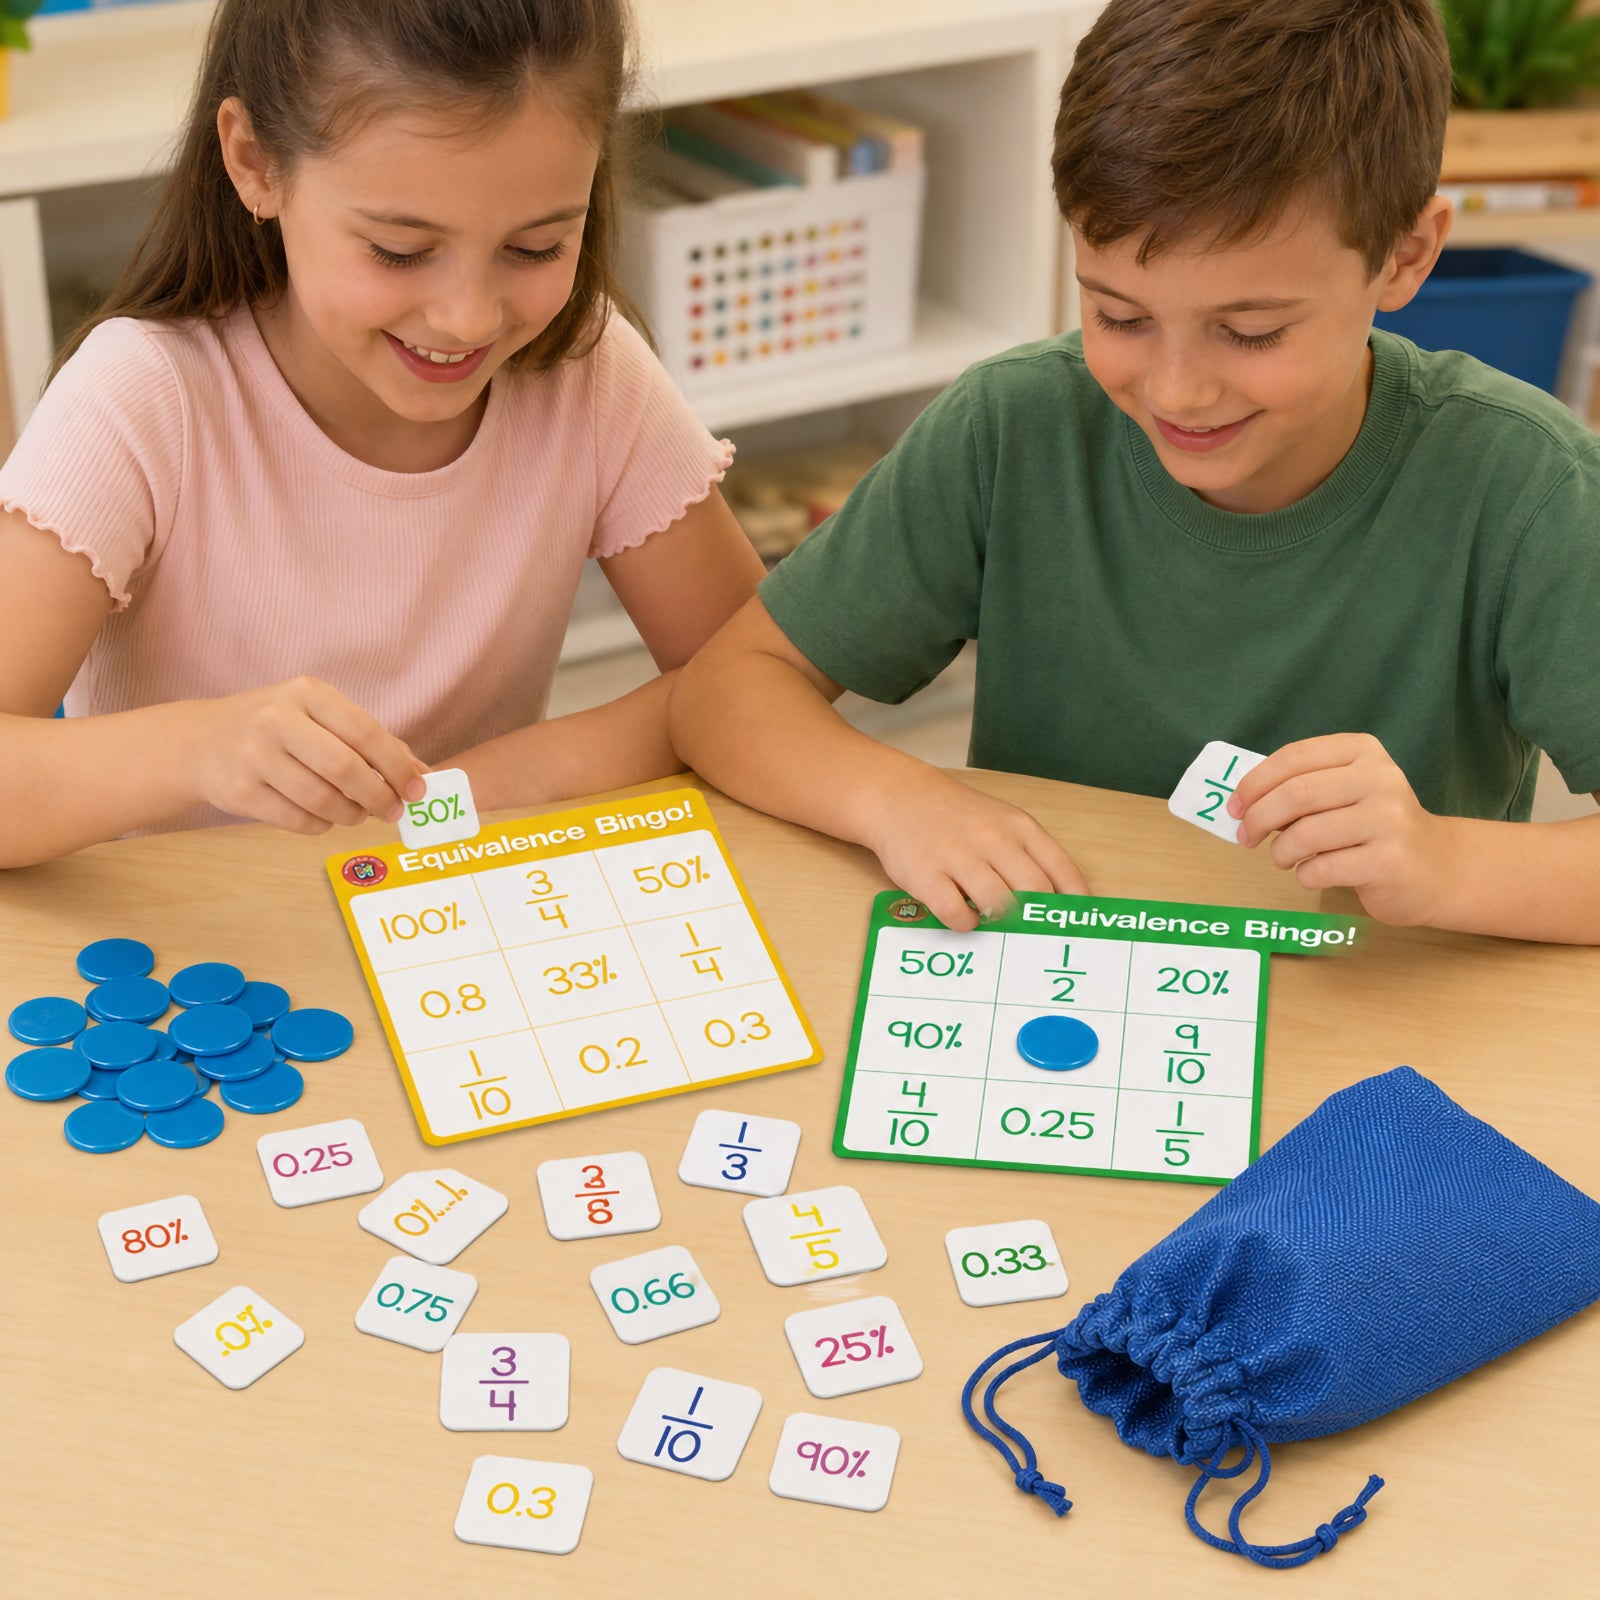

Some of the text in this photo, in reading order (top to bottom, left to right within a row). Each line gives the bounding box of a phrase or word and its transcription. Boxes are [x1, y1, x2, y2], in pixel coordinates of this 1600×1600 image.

[408, 793, 465, 827] 50%
[1197, 792, 1223, 821] 2
[397, 823, 586, 872] Equivalence
[594, 800, 695, 837] Bingo!
[526, 870, 554, 895] 3
[633, 855, 710, 894] 50%
[380, 902, 466, 943] 100%
[538, 904, 568, 928] 4
[1022, 903, 1357, 947] Equivalence Bingo!
[543, 954, 617, 995] 33%
[692, 957, 723, 981] 4
[900, 950, 973, 976] 50%
[1052, 978, 1074, 1002] 2
[1157, 967, 1228, 995] 20%
[420, 983, 486, 1018] 0.8
[704, 1012, 771, 1048] 0.3
[888, 1021, 961, 1049] 90%
[1176, 1025, 1198, 1049] 9
[579, 1037, 648, 1074] 0.2
[1168, 1058, 1204, 1084] 10
[469, 1087, 511, 1119] 10
[902, 1081, 926, 1107] 4
[890, 1118, 929, 1146] 10
[1001, 1108, 1094, 1139] 0.25
[273, 1143, 352, 1177] 0.25
[722, 1154, 747, 1180] 3
[1165, 1139, 1189, 1166] 5
[791, 1204, 824, 1227] 4
[122, 1218, 188, 1254] 80%
[806, 1239, 839, 1270] 5
[962, 1245, 1047, 1278] 0.33
[377, 1283, 453, 1322] 0.75
[611, 1272, 695, 1314] 0.66
[492, 1347, 515, 1376] 3
[816, 1326, 894, 1367] 25%
[490, 1391, 515, 1420] 4
[654, 1426, 702, 1463] 10
[798, 1442, 869, 1477] 90%
[487, 1482, 556, 1519] 0.3
